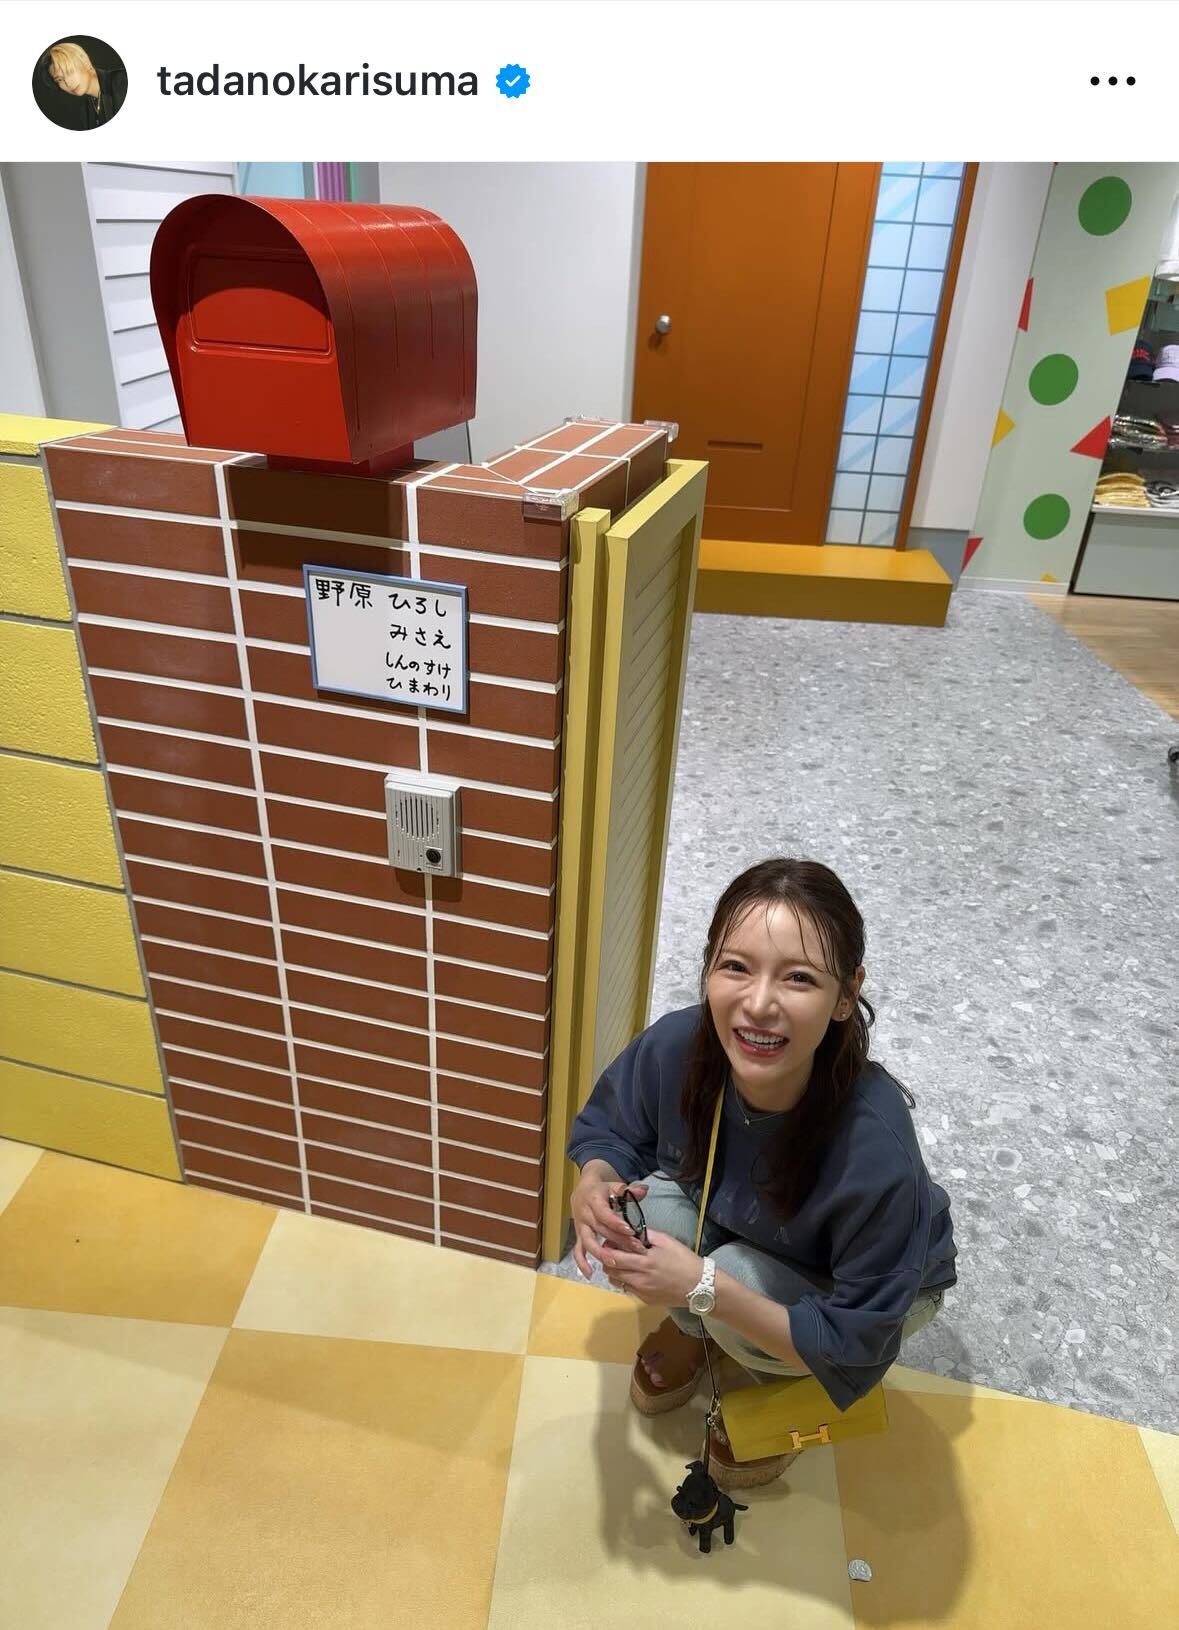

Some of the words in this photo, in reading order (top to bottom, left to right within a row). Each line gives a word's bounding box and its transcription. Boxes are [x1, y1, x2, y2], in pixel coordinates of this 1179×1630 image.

[315, 578, 373, 609] 野原
[388, 593, 447, 617] ひろし
[389, 623, 451, 649] みさえ
[385, 651, 452, 679] しんのすけ
[386, 677, 451, 701] ひまわり
